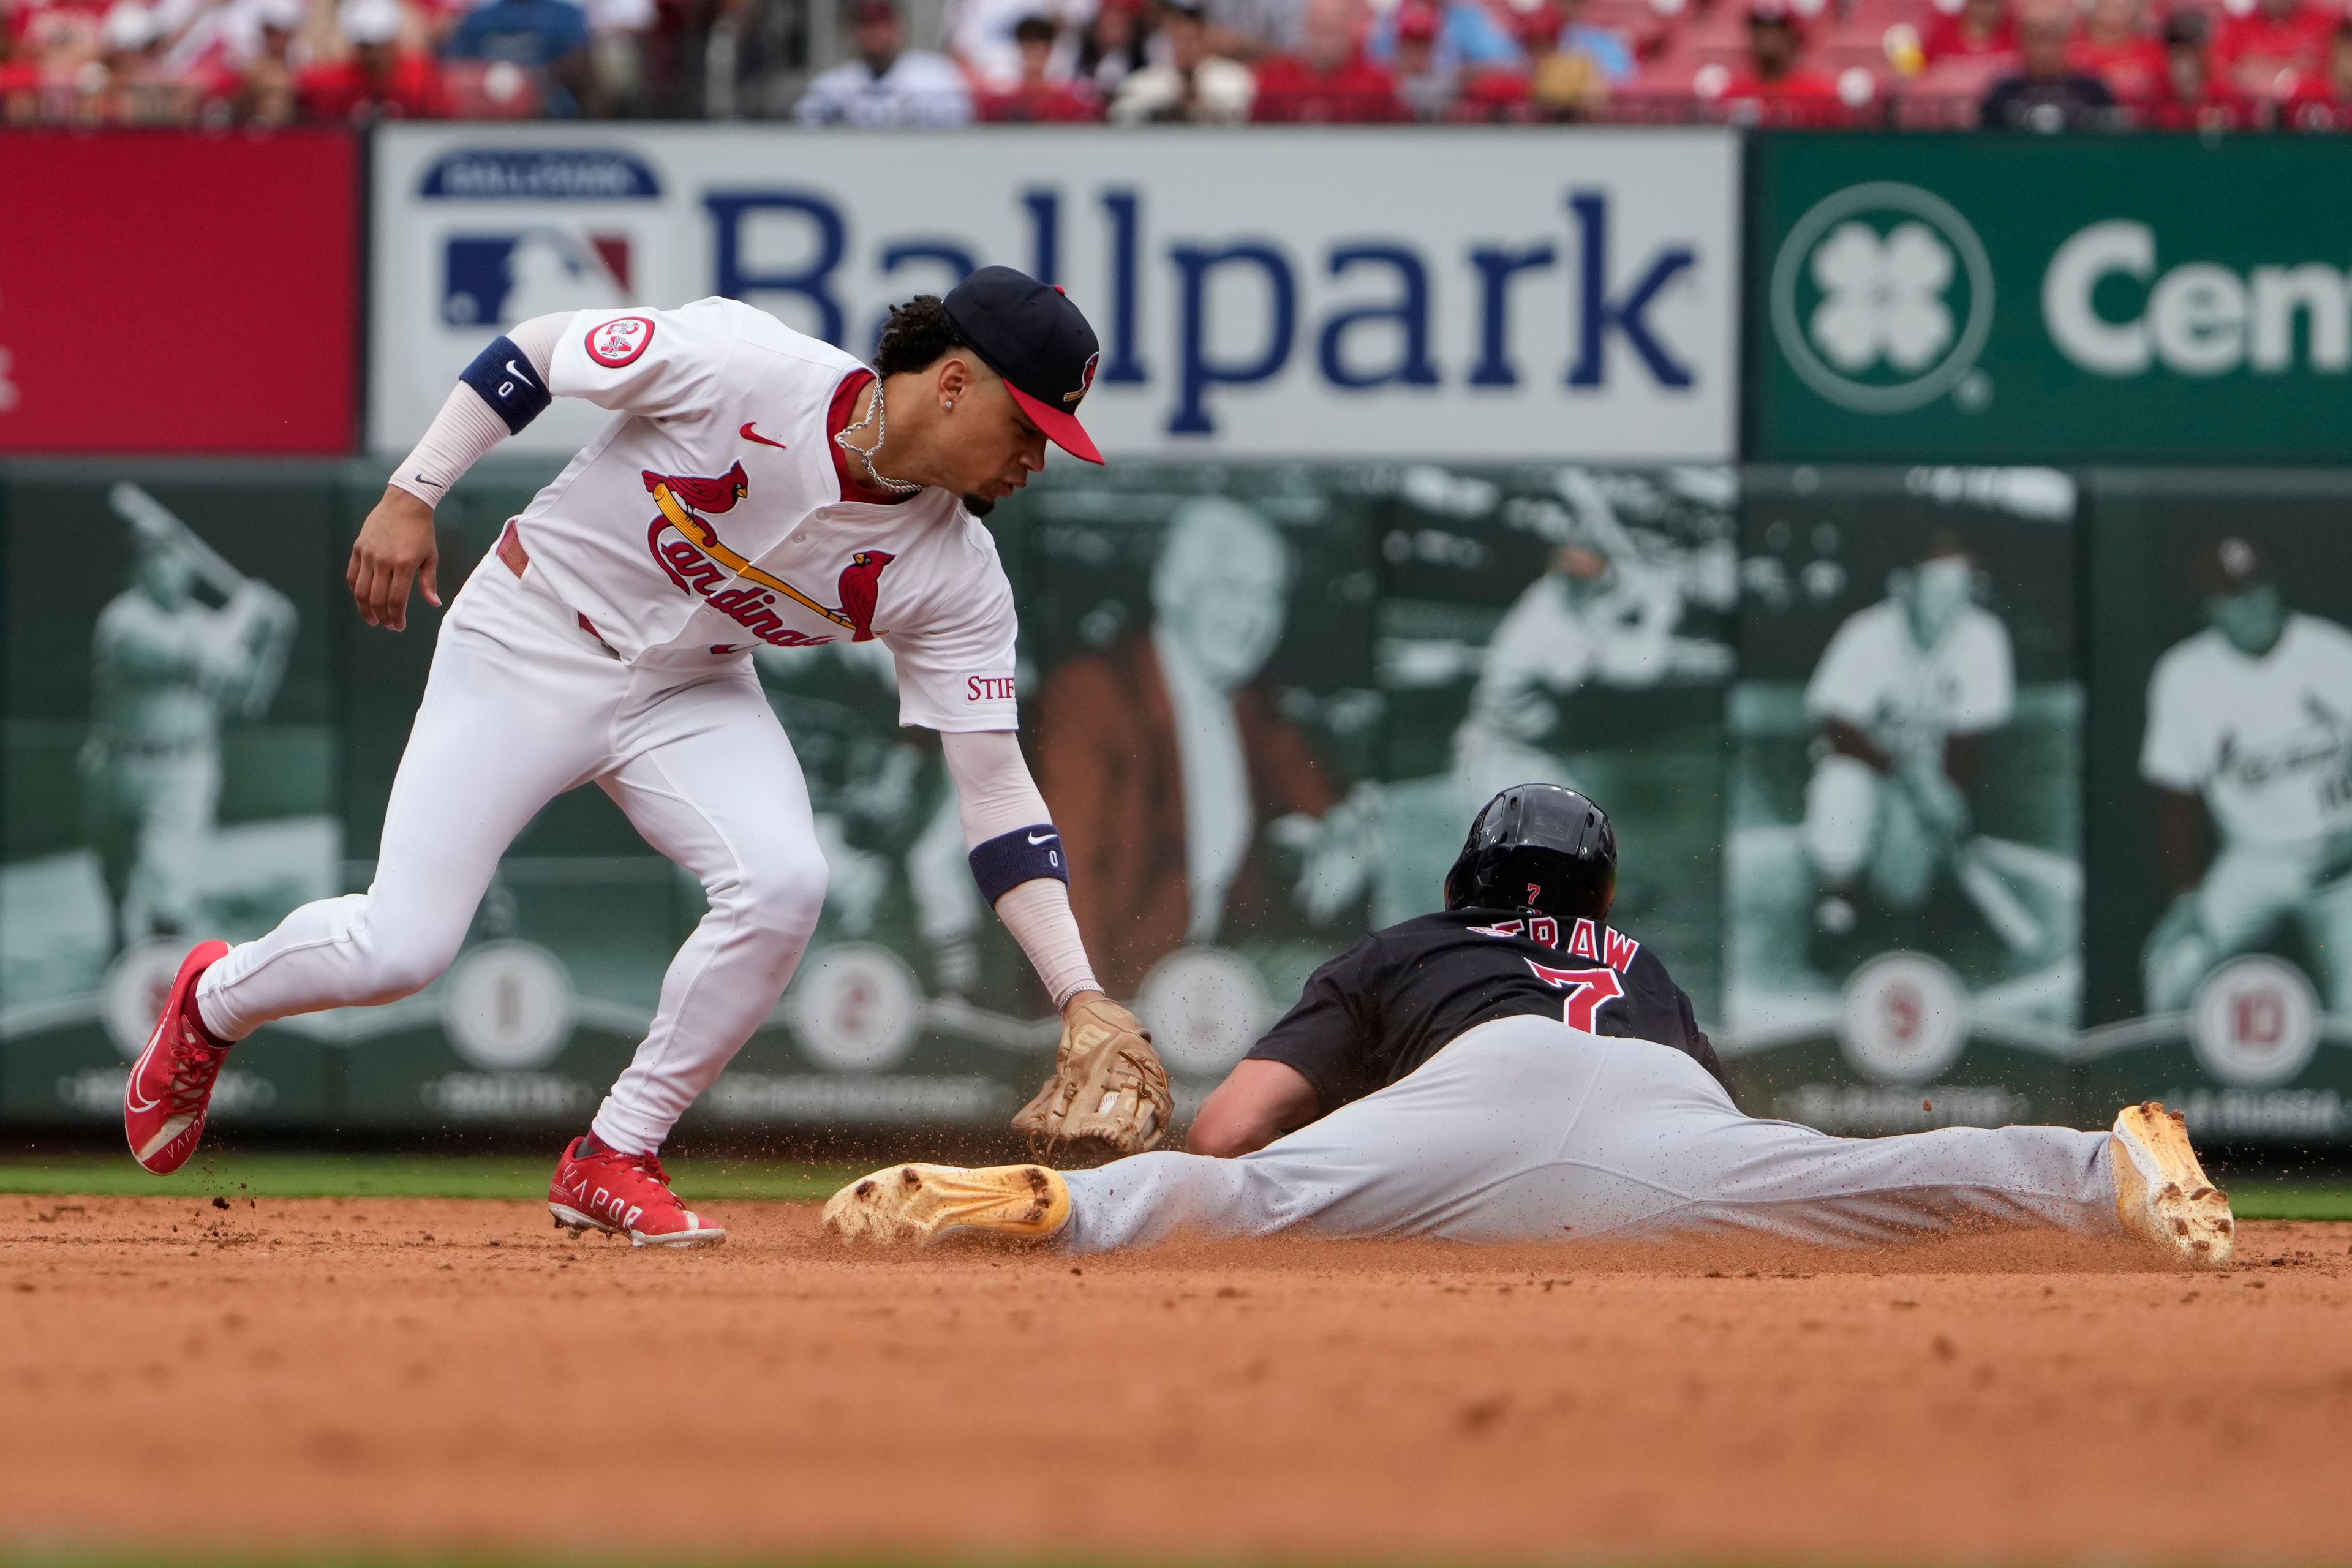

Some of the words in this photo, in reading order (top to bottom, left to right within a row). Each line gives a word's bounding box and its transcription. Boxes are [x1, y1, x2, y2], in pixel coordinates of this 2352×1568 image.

[498, 381, 514, 397] 0
[647, 513, 838, 647] Cardina
[968, 676, 1015, 701] STIF
[1049, 850, 1058, 867] 0
[1527, 883, 1540, 905] 7
[1466, 916, 1640, 974] RAW
[1523, 957, 1624, 1035] 7
